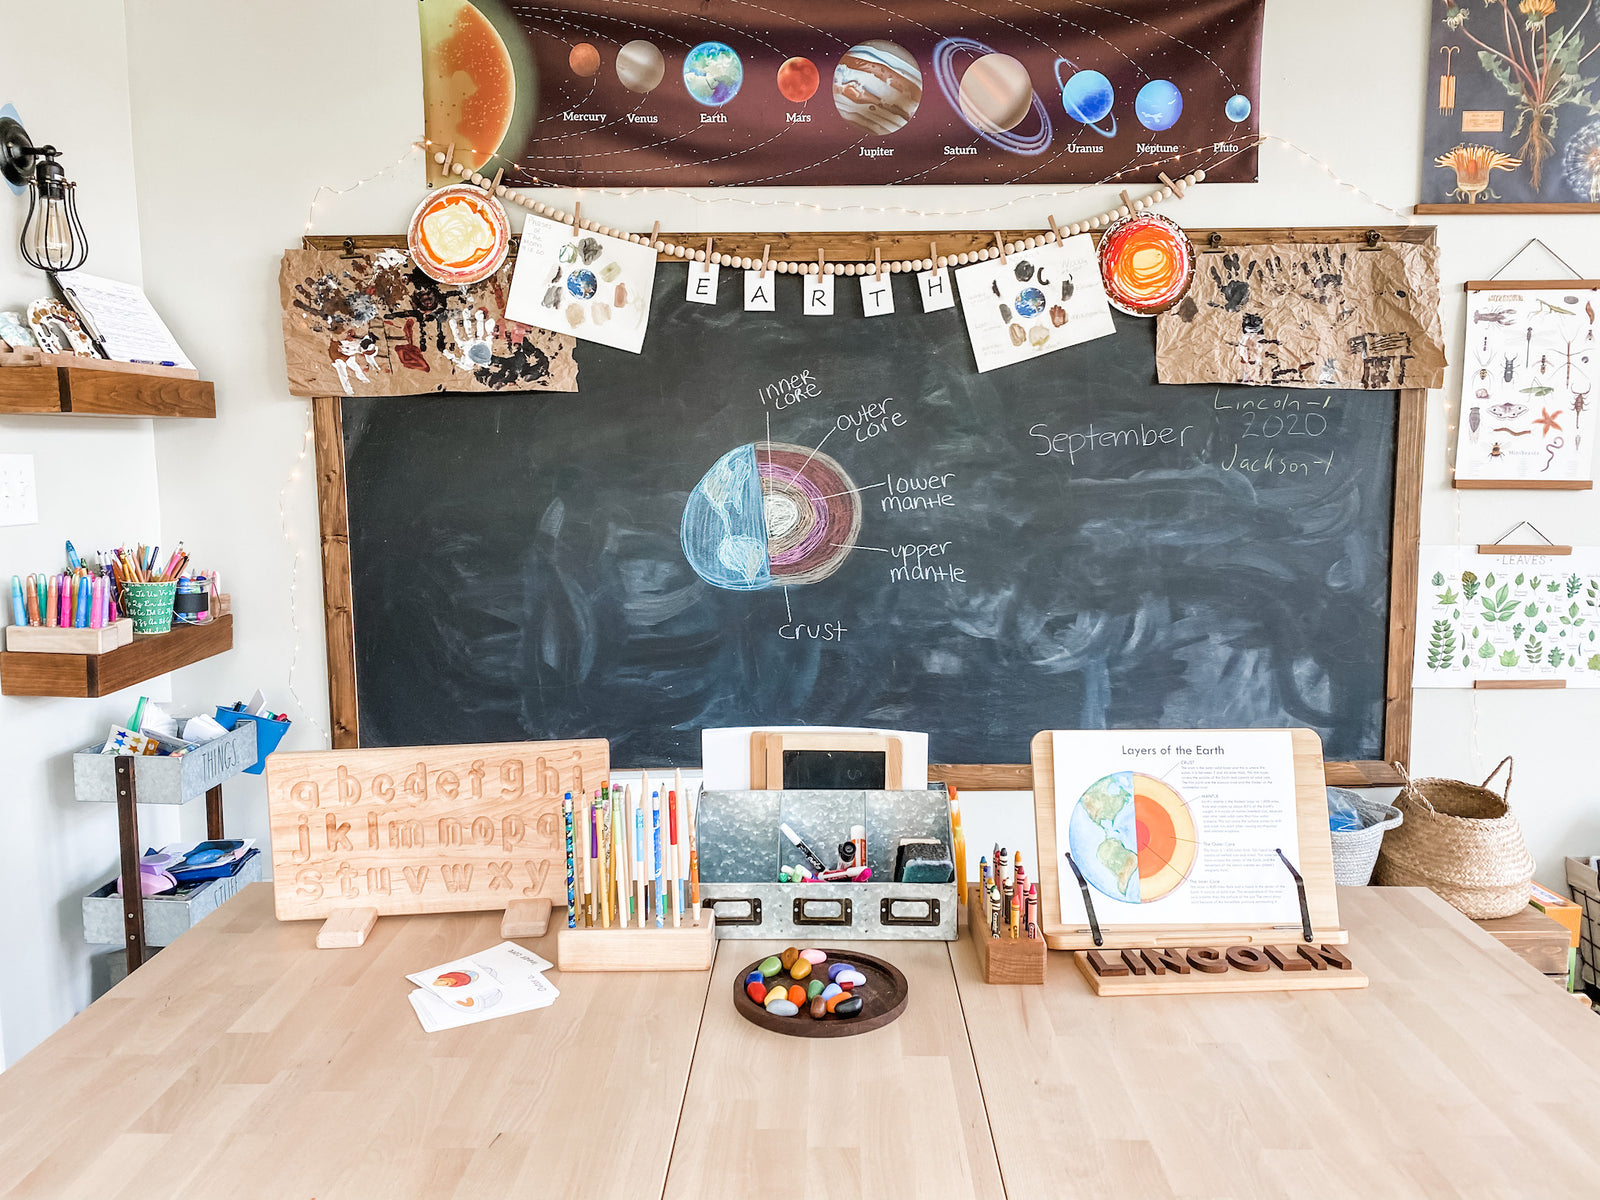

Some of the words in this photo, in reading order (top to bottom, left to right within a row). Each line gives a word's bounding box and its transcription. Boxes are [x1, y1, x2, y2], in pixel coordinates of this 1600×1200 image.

[563, 112, 606, 123] Mercury
[627, 113, 658, 123] Venus
[700, 113, 728, 123] Earth
[786, 113, 812, 123] Mars
[859, 146, 894, 158] Jupiter
[944, 145, 977, 155] Saturn
[1068, 143, 1103, 153] Uranus
[1136, 143, 1179, 155] Neptune
[1213, 142, 1239, 152] Pluto
[1242, 410, 1327, 439] 2020
[1029, 423, 1194, 466] September
[886, 473, 956, 496] lower
[881, 493, 956, 513] mantle
[890, 541, 953, 568] upper
[1502, 555, 1547, 566] LEAVES
[890, 563, 967, 583] mantle
[1122, 745, 1157, 757] Layers
[1160, 745, 1171, 755] of
[1176, 745, 1192, 755] the
[1196, 745, 1225, 755] Earth
[1086, 944, 1352, 977] LINCOLN
